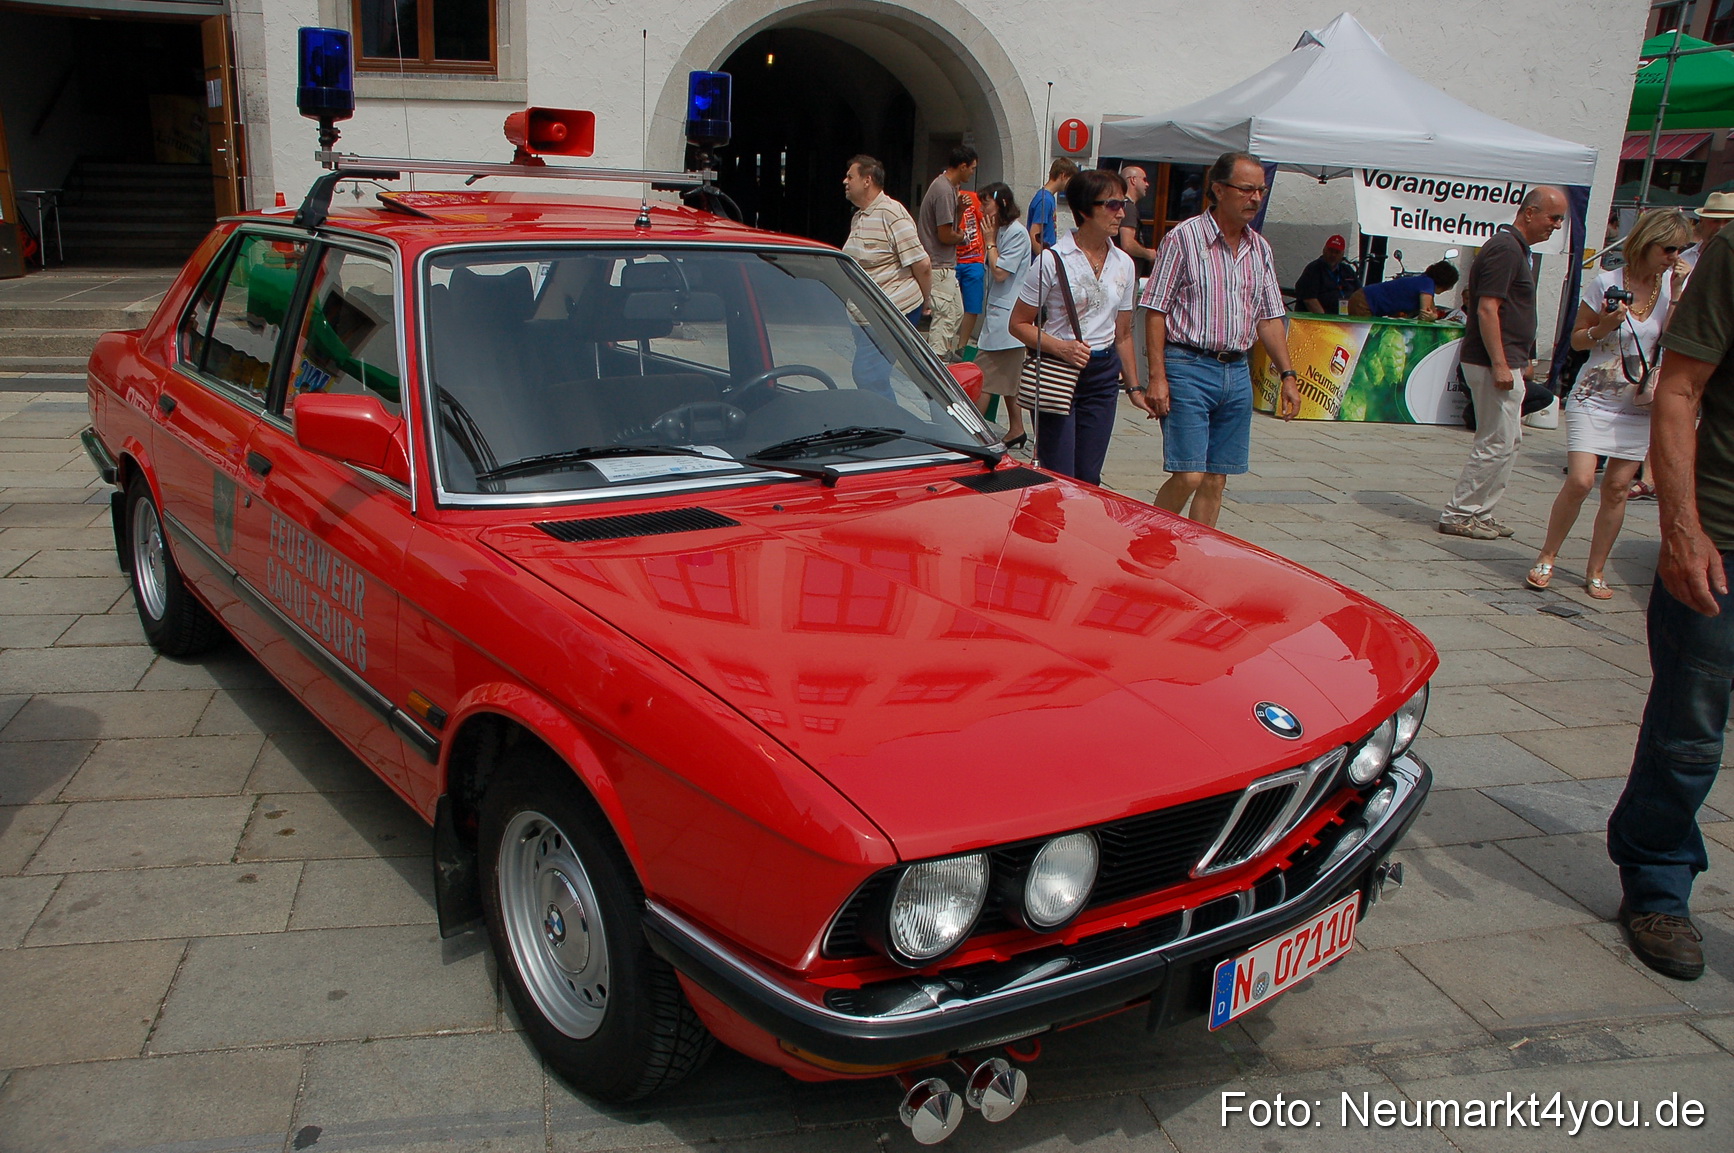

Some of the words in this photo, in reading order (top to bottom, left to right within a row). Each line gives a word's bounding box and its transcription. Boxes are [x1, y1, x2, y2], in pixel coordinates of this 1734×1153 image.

[1362, 168, 1527, 205] Vorangemeld
[268, 556, 367, 673] CADOLZBURG
[270, 512, 366, 619] FEUERWEHR
[1217, 1001, 1226, 1016] D
[1233, 957, 1255, 1010] N
[1274, 902, 1355, 986] 07110
